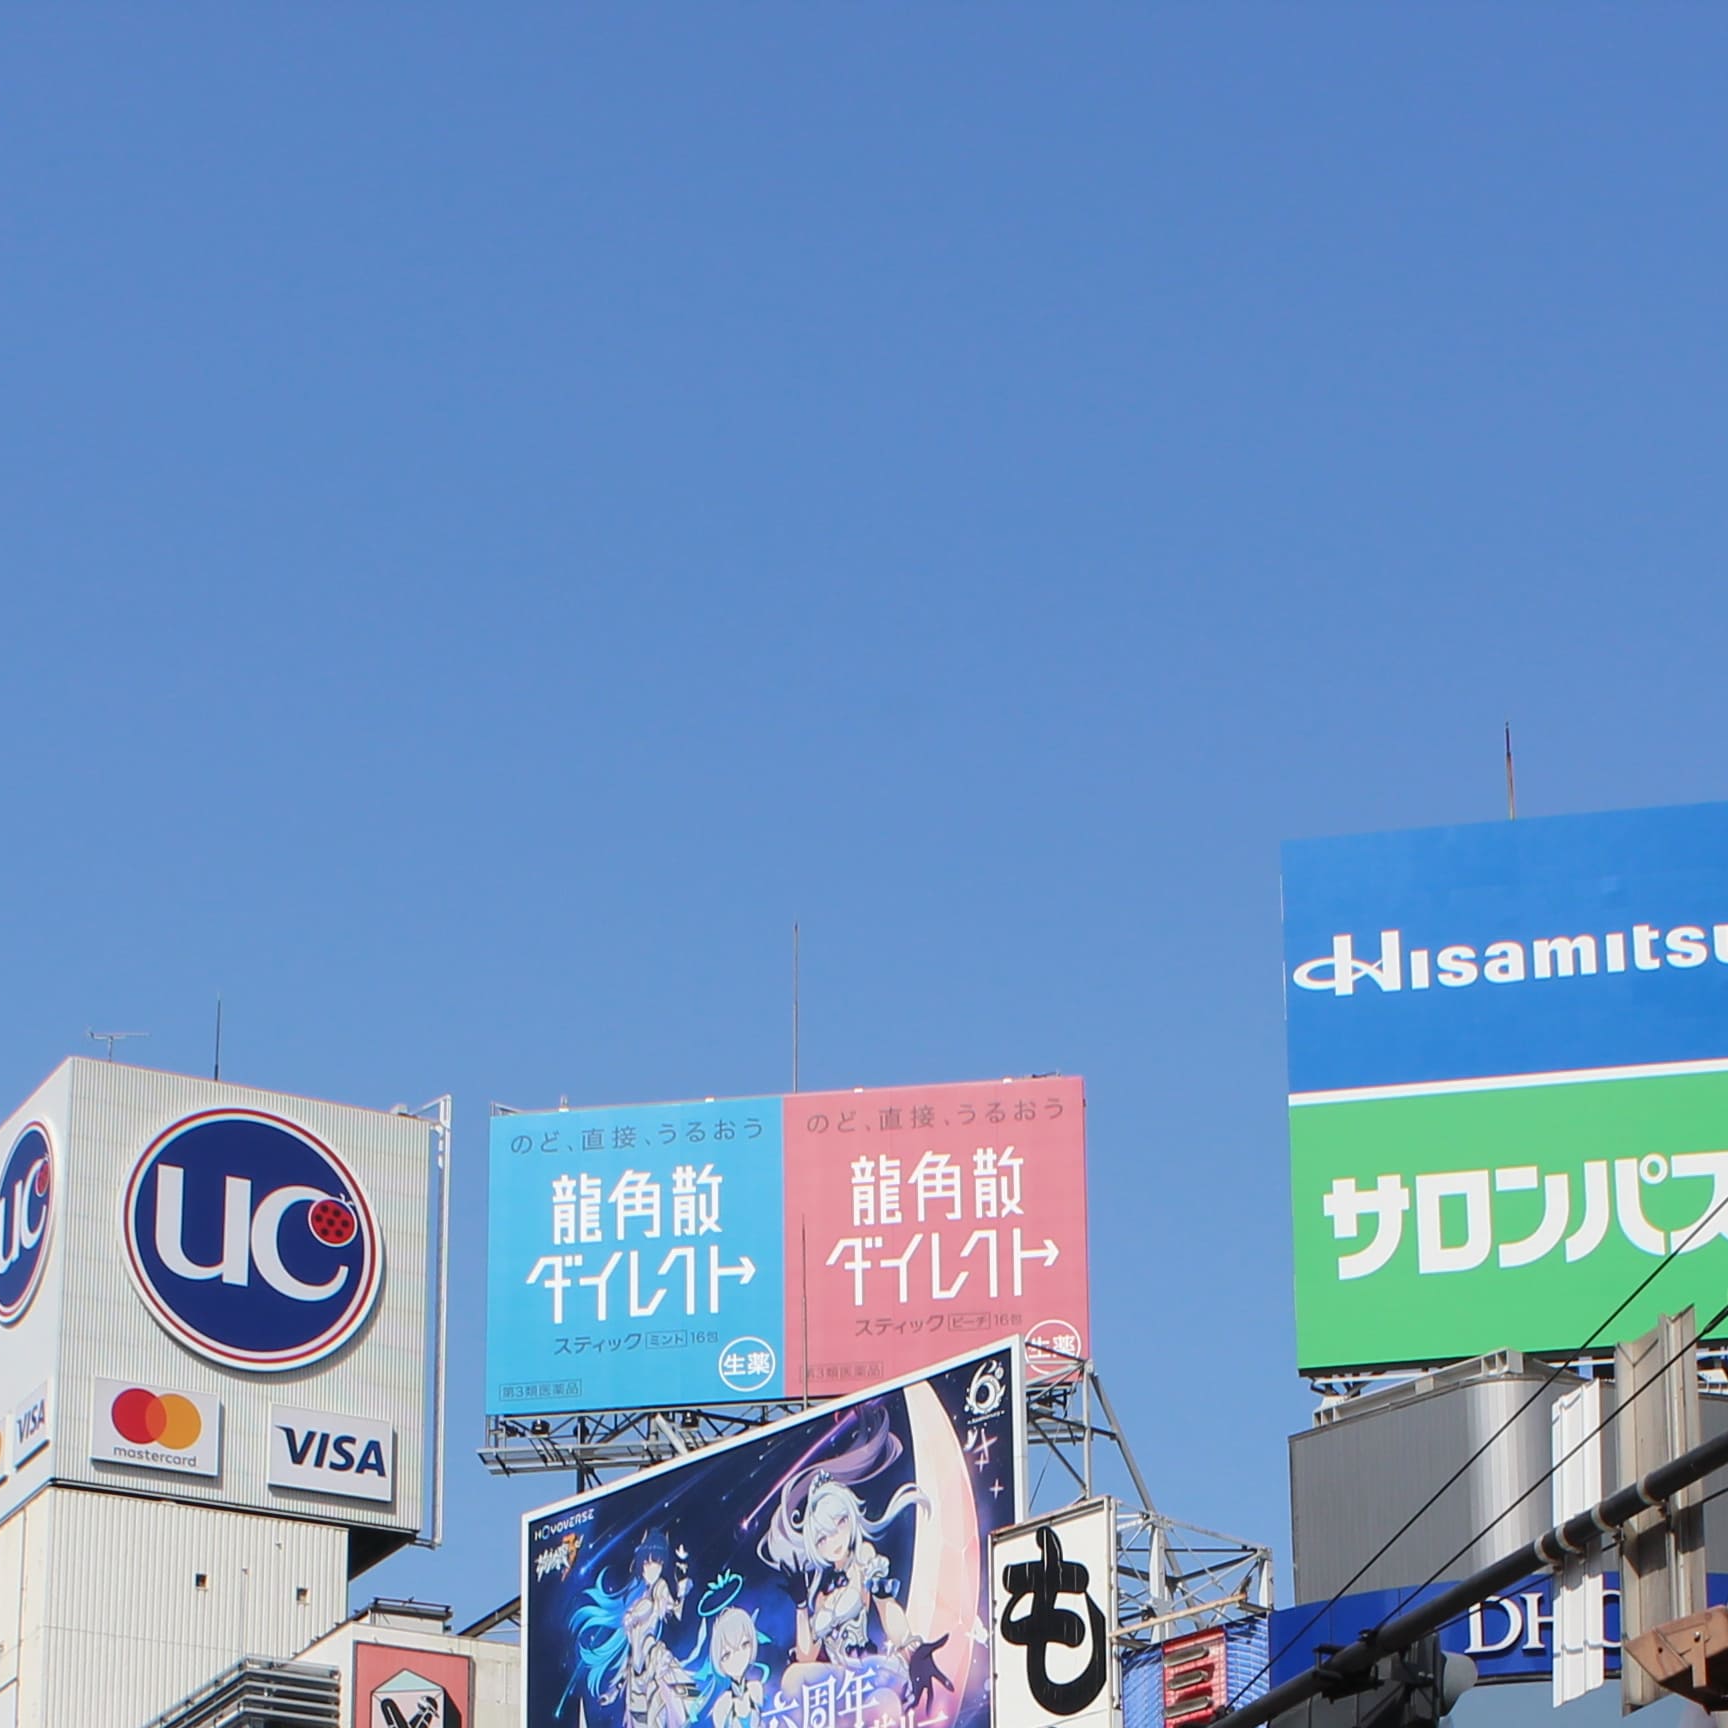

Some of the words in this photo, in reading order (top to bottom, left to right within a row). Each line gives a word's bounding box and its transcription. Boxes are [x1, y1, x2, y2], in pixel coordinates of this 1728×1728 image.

[510, 1116, 765, 1156] のど、直接、うるおう
[806, 1097, 1065, 1137] のど、直接、うるおう
[551, 1162, 724, 1247] 龍角散
[850, 1145, 1025, 1227] 龍角散
[525, 1243, 758, 1325] ダイレクト
[825, 1226, 1061, 1307] ダイレクト
[553, 1330, 643, 1357] スティック
[854, 1314, 946, 1339] スティック
[722, 1352, 773, 1379] 生薬
[16, 1398, 46, 1439] VISA
[112, 1445, 199, 1469] mastercard
[275, 1423, 388, 1479] VISA
